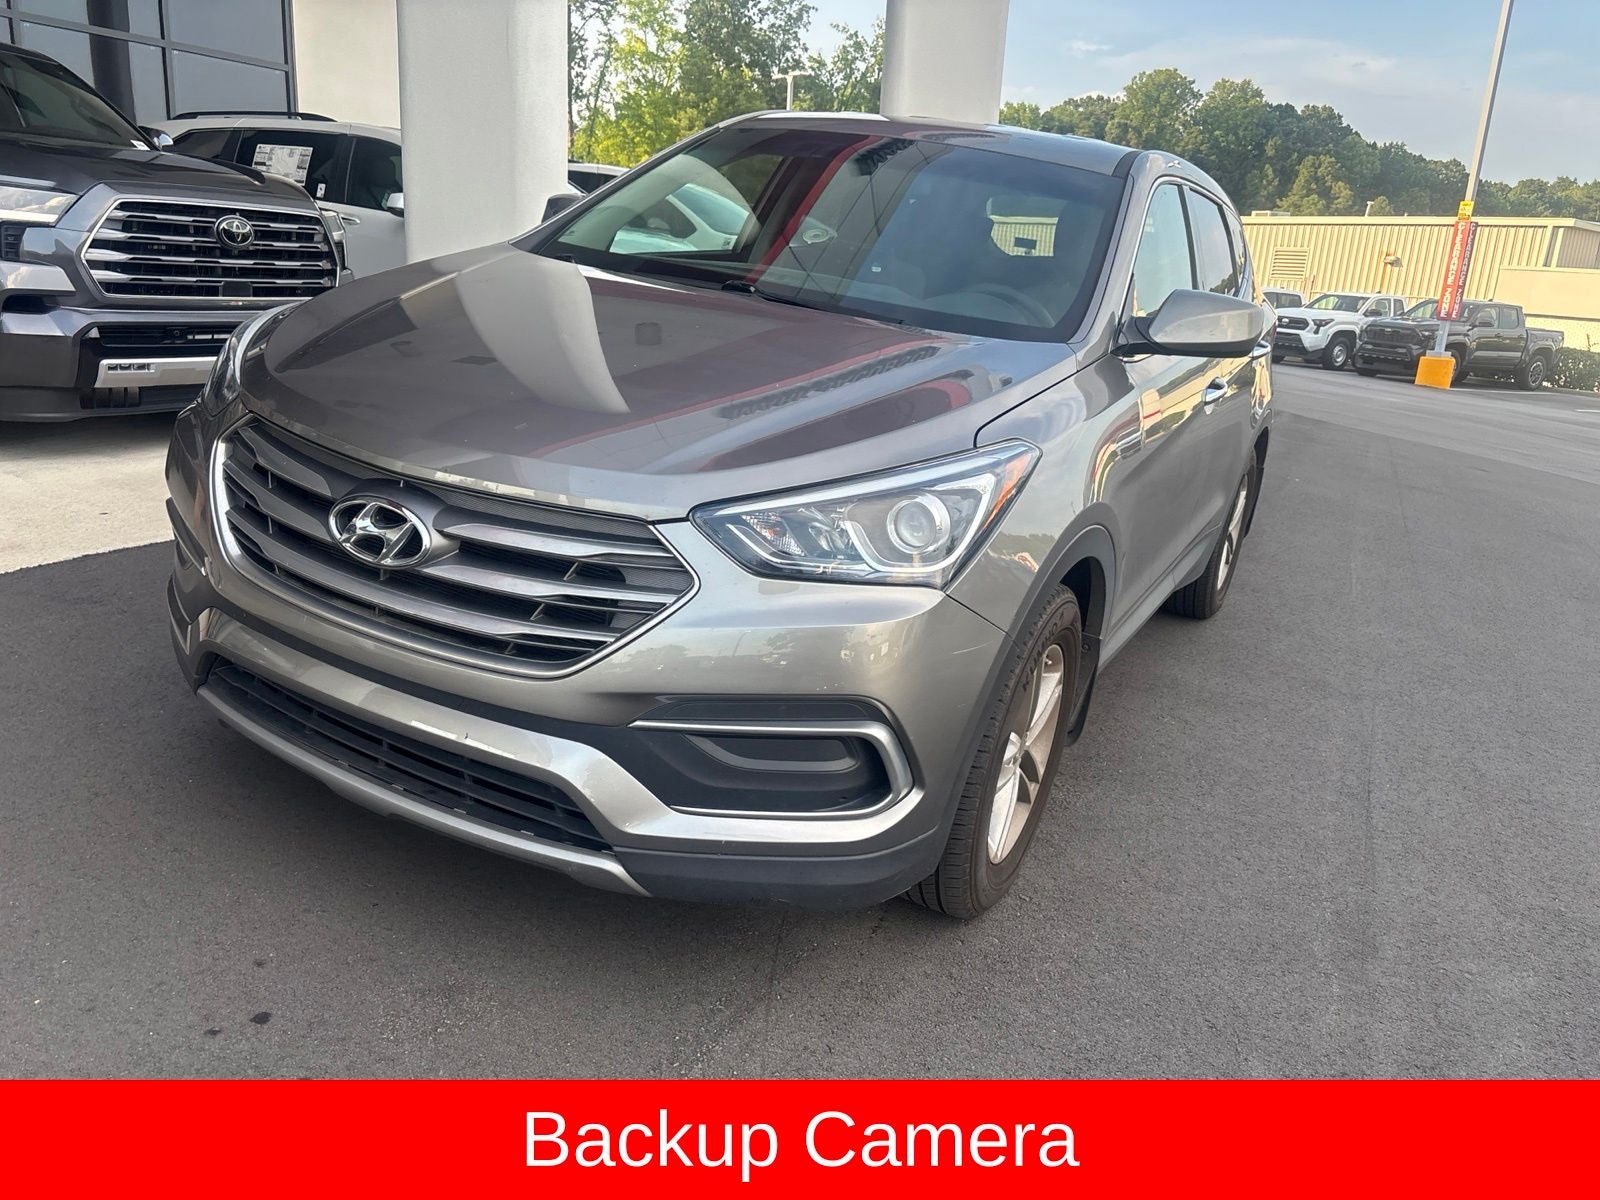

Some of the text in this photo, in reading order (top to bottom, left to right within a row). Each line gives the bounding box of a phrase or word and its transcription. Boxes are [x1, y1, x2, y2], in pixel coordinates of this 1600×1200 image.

[1447, 222, 1466, 286] CLEARANCE
[1459, 222, 1476, 286] CLEARANCE
[1440, 287, 1452, 318] ZONE
[1452, 288, 1463, 318] ZONE
